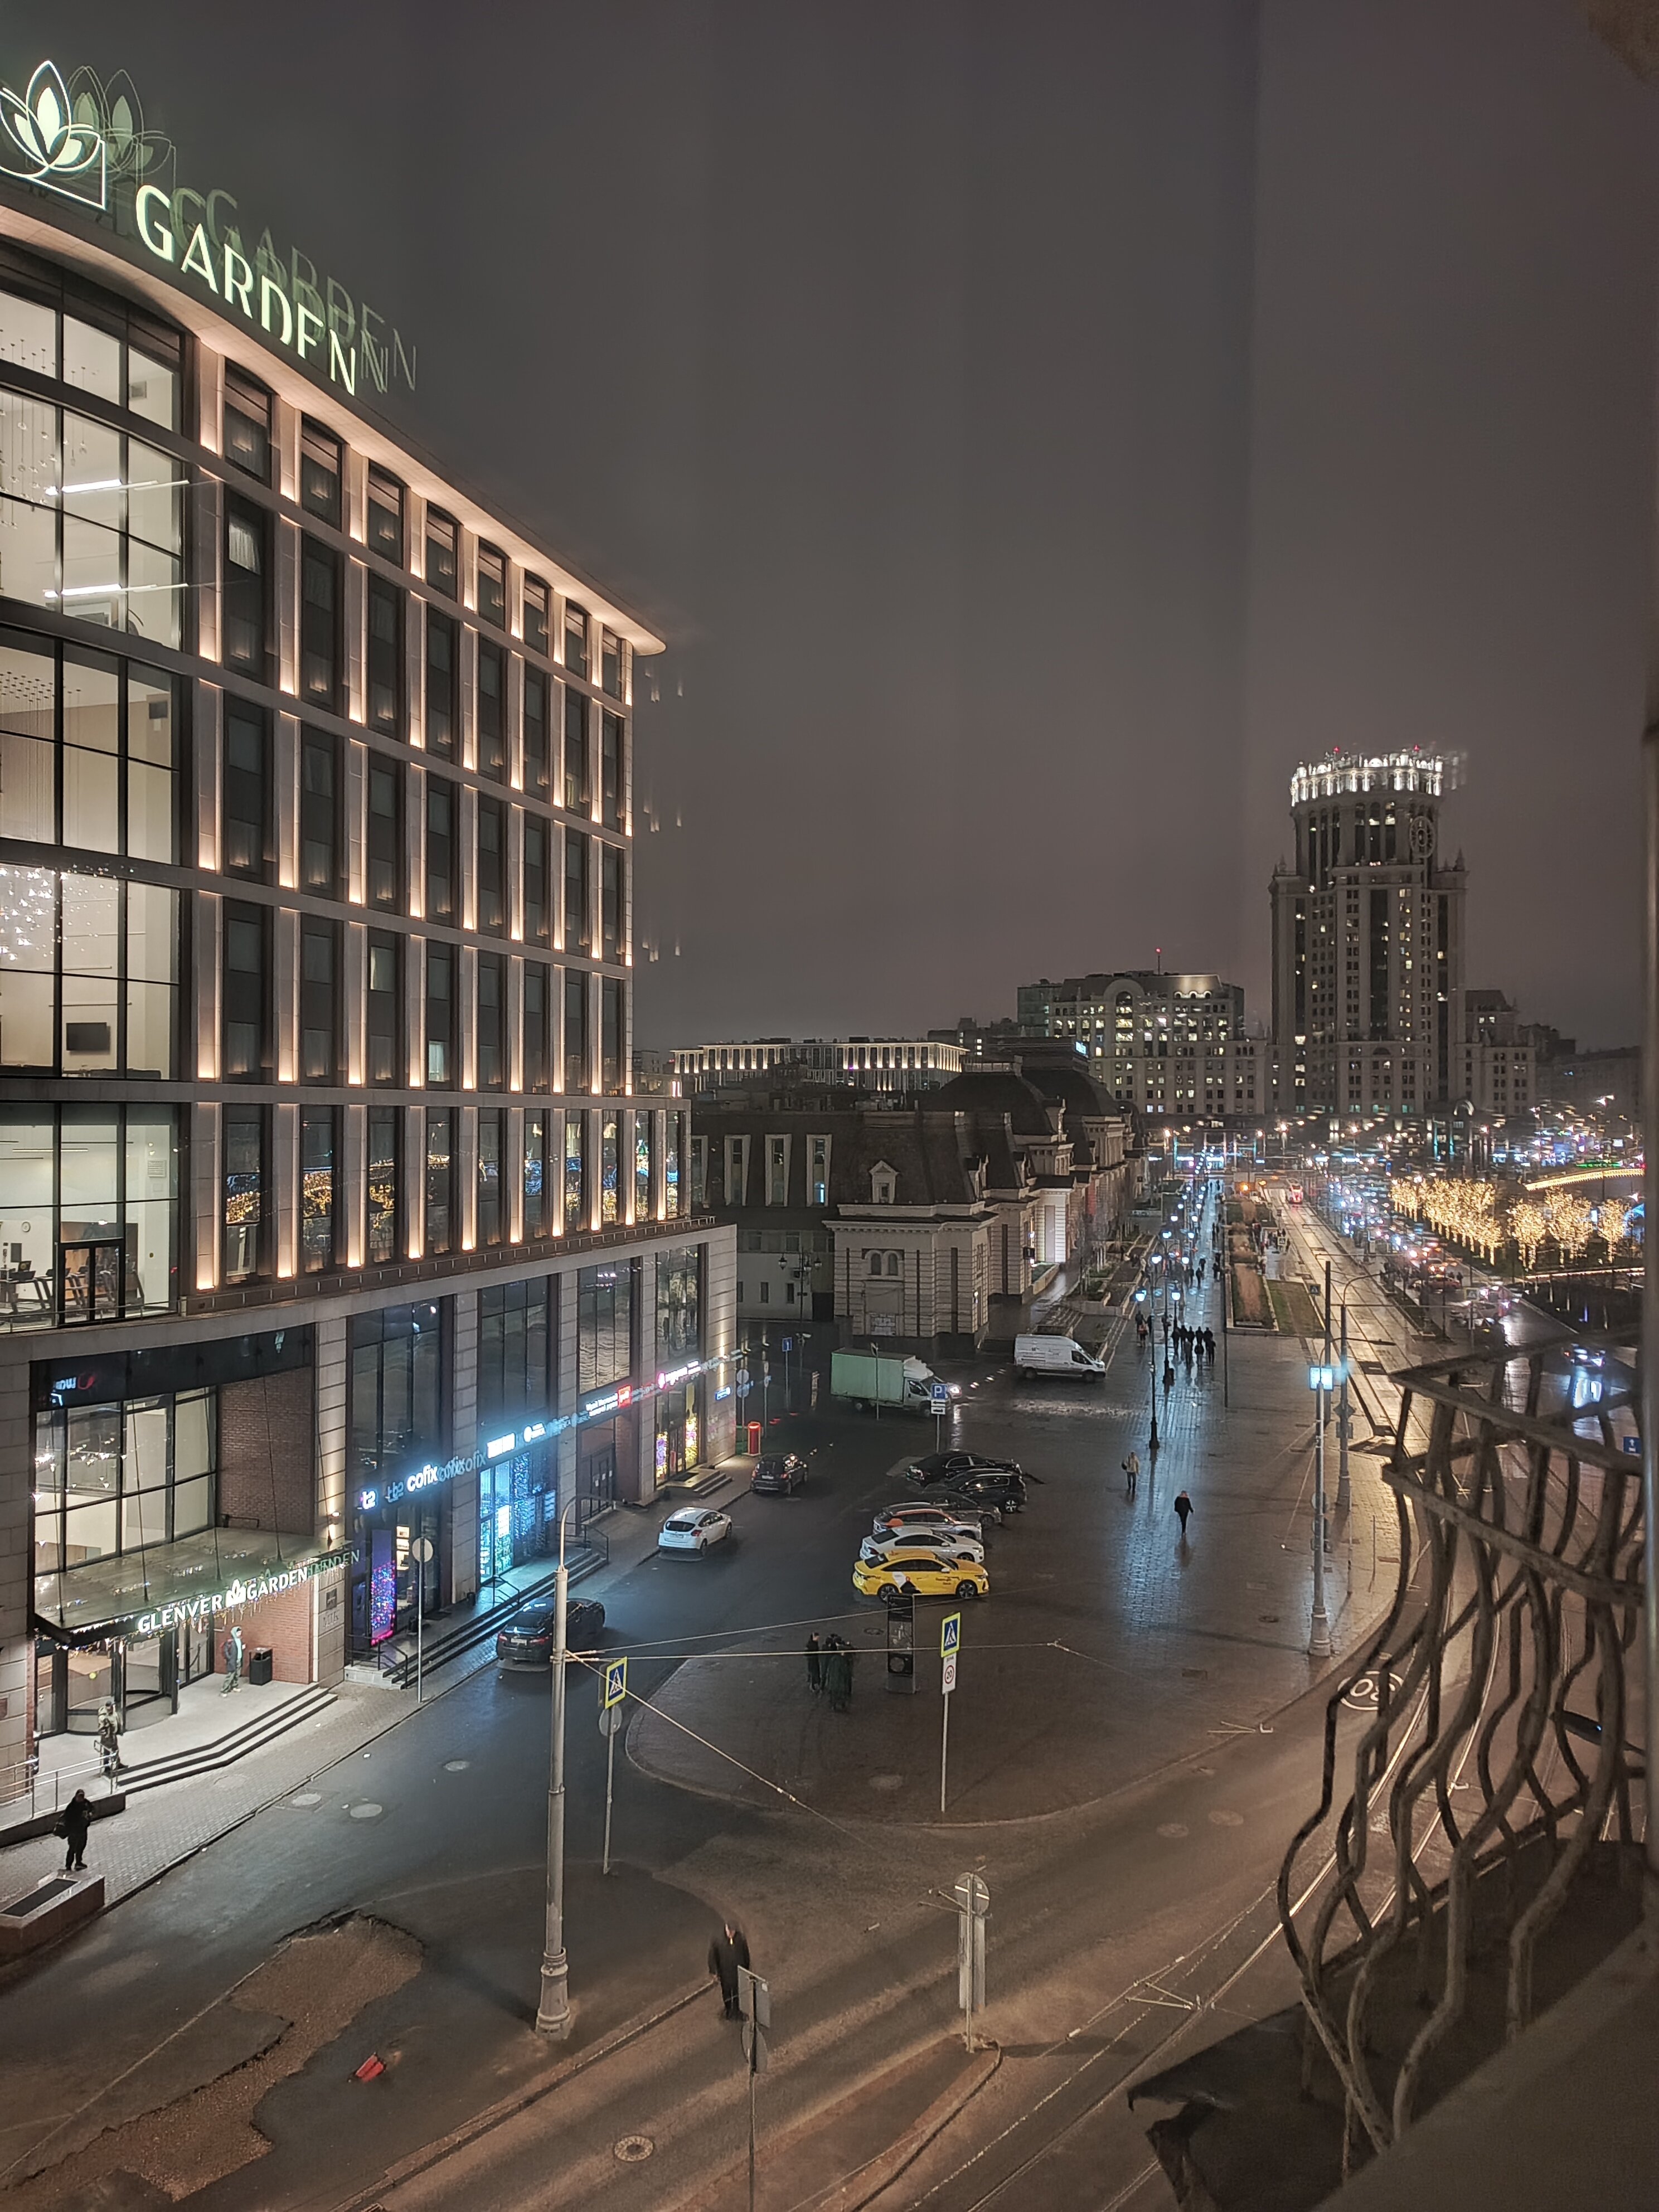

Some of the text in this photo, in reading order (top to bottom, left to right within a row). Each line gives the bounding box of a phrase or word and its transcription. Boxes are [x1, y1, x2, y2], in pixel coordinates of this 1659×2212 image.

[136, 185, 355, 396] GARDEN
[934, 1385, 943, 1398] P
[406, 1464, 438, 1492] cofix
[362, 1491, 376, 1510] t2
[138, 1566, 308, 1633] GLENVER GARDEN
[946, 1669, 953, 1680] 20
